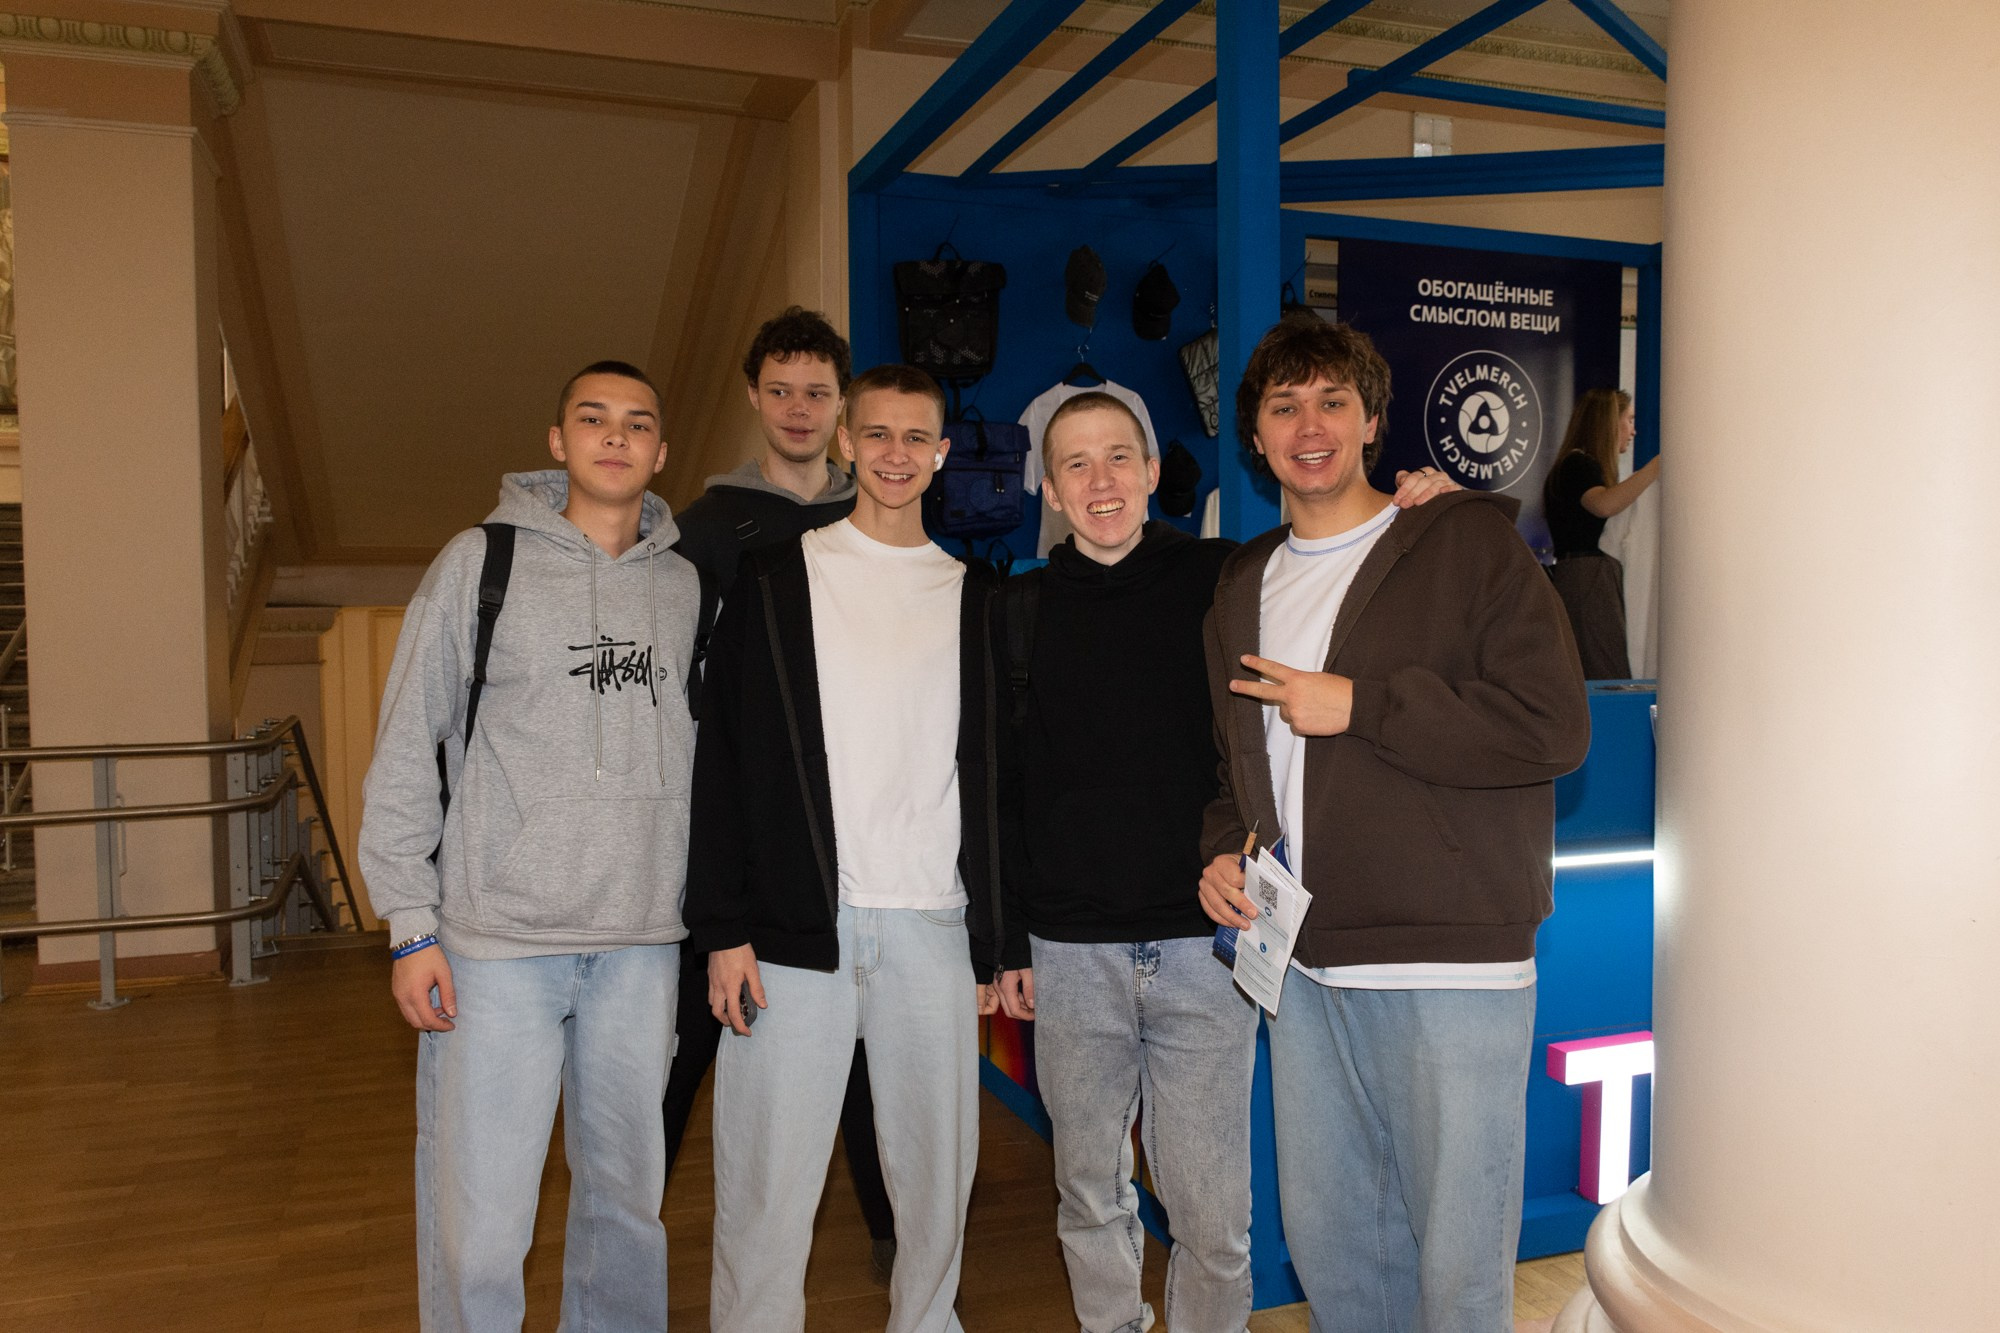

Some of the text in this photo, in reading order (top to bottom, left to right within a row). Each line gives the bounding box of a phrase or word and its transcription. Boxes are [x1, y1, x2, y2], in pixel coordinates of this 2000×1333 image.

[1418, 278, 1554, 306] ОБОГАЩЁННЫЕ
[1409, 304, 1560, 335] СМЫСЛОМ ВЕЩИ
[1439, 364, 1528, 409] TVELMERCH
[1440, 435, 1528, 480] TVELMERCH
